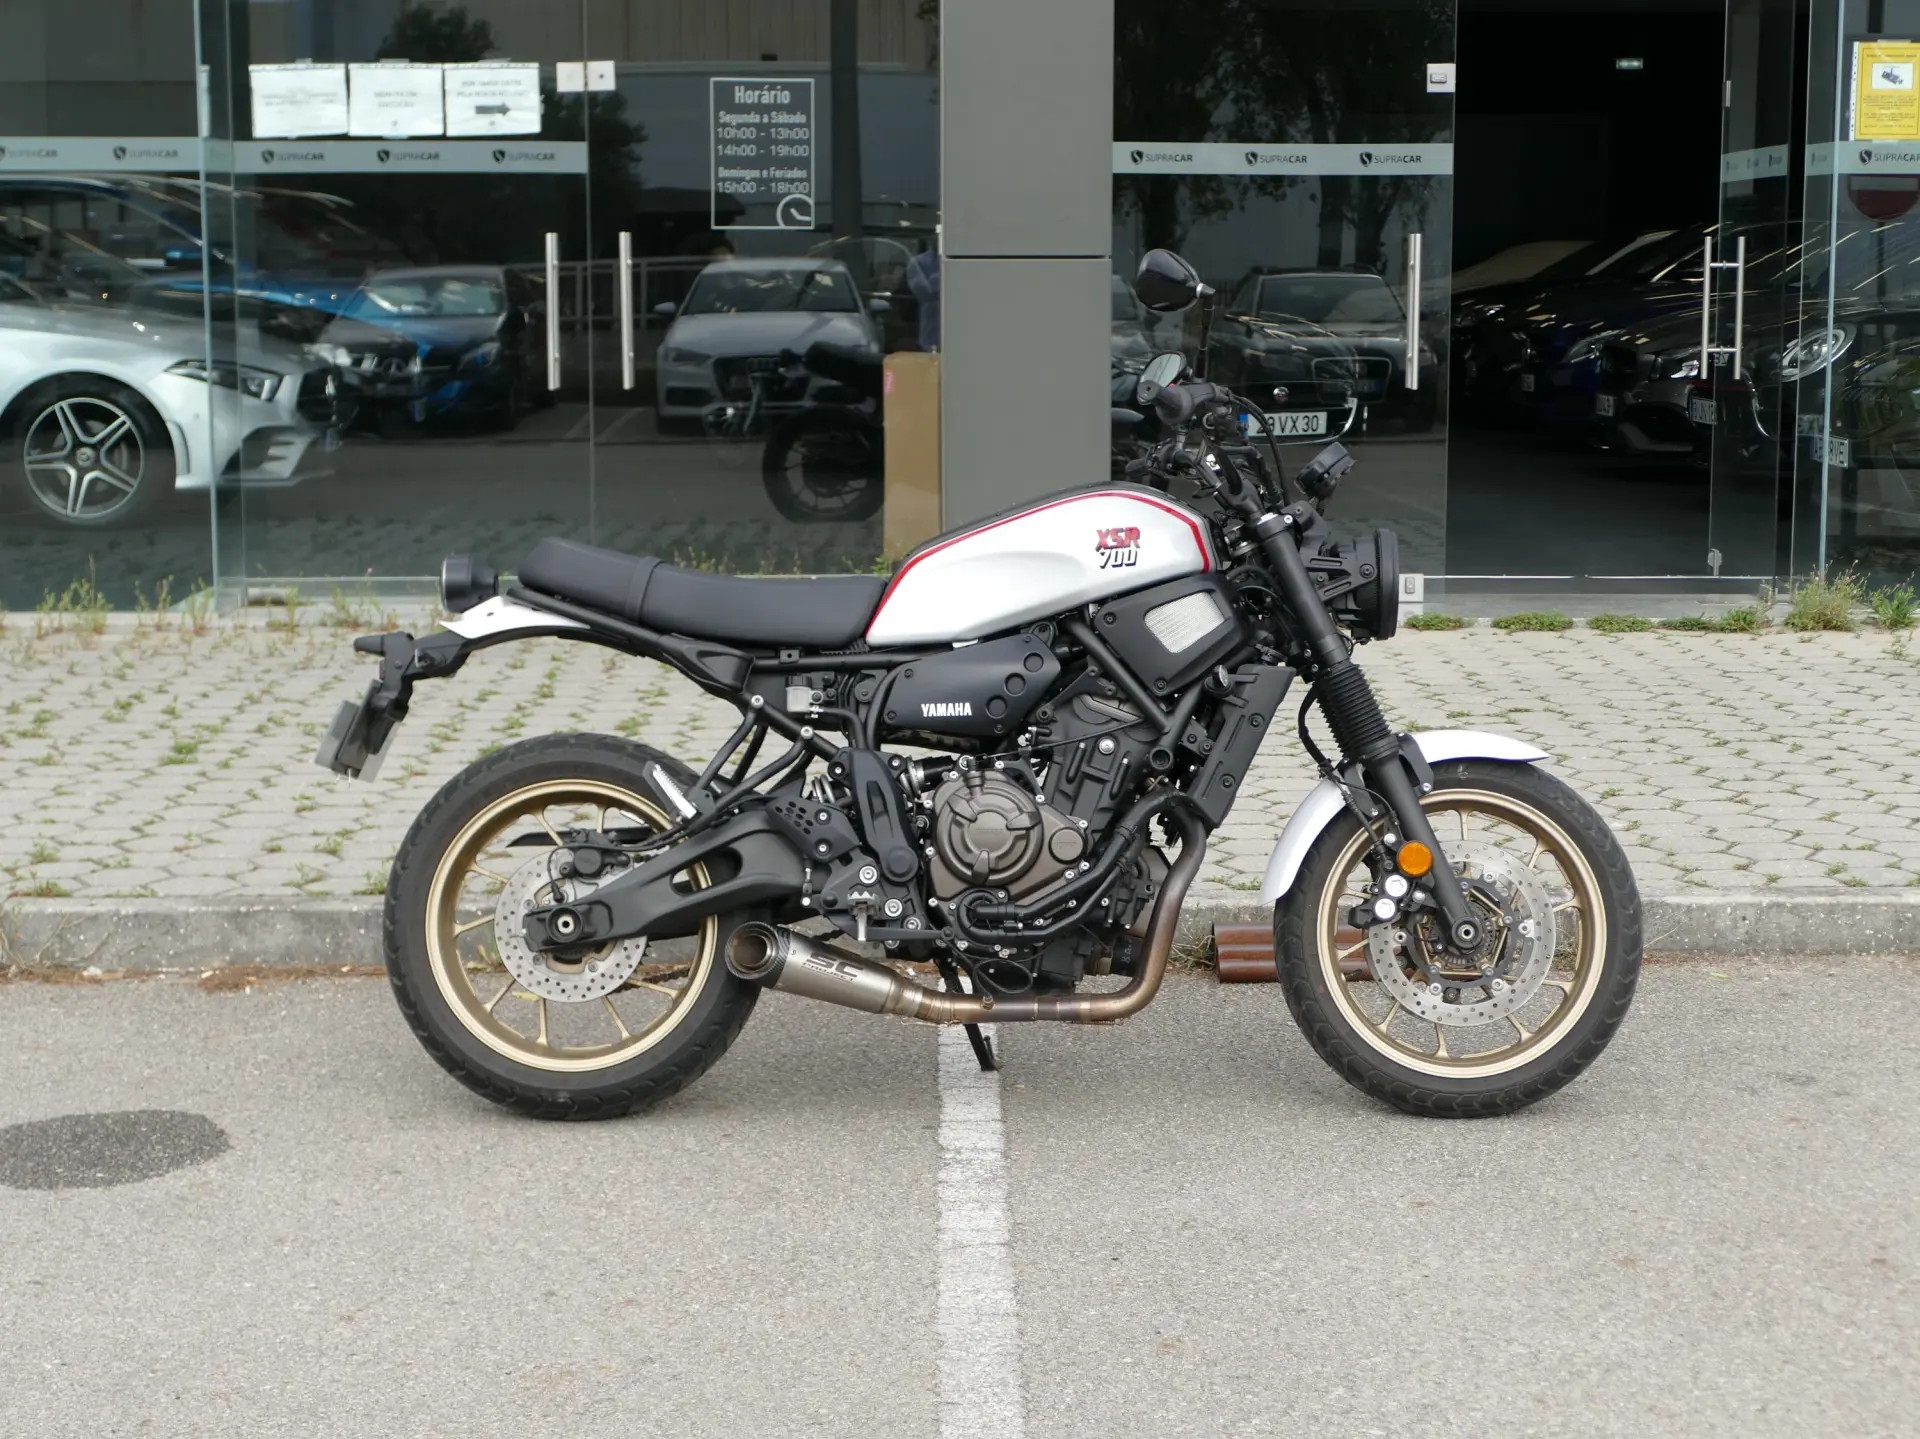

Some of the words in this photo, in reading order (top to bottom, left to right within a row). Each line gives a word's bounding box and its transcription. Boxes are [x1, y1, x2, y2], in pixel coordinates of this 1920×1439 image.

[734, 84, 791, 104] Horário
[717, 127, 757, 139] 10h00
[770, 127, 810, 140] 13h00
[717, 144, 757, 157] 14h00
[770, 144, 810, 157] 19h00
[1145, 153, 1193, 162] SUPRACAR
[1259, 154, 1308, 164] SUPRACAR
[1374, 154, 1422, 164] SUPRACAR
[717, 181, 757, 193] 15h00
[770, 181, 810, 194] 18h00
[1095, 526, 1141, 552] XSR
[1099, 549, 1138, 569] 700
[920, 702, 972, 717] YAMAHA
